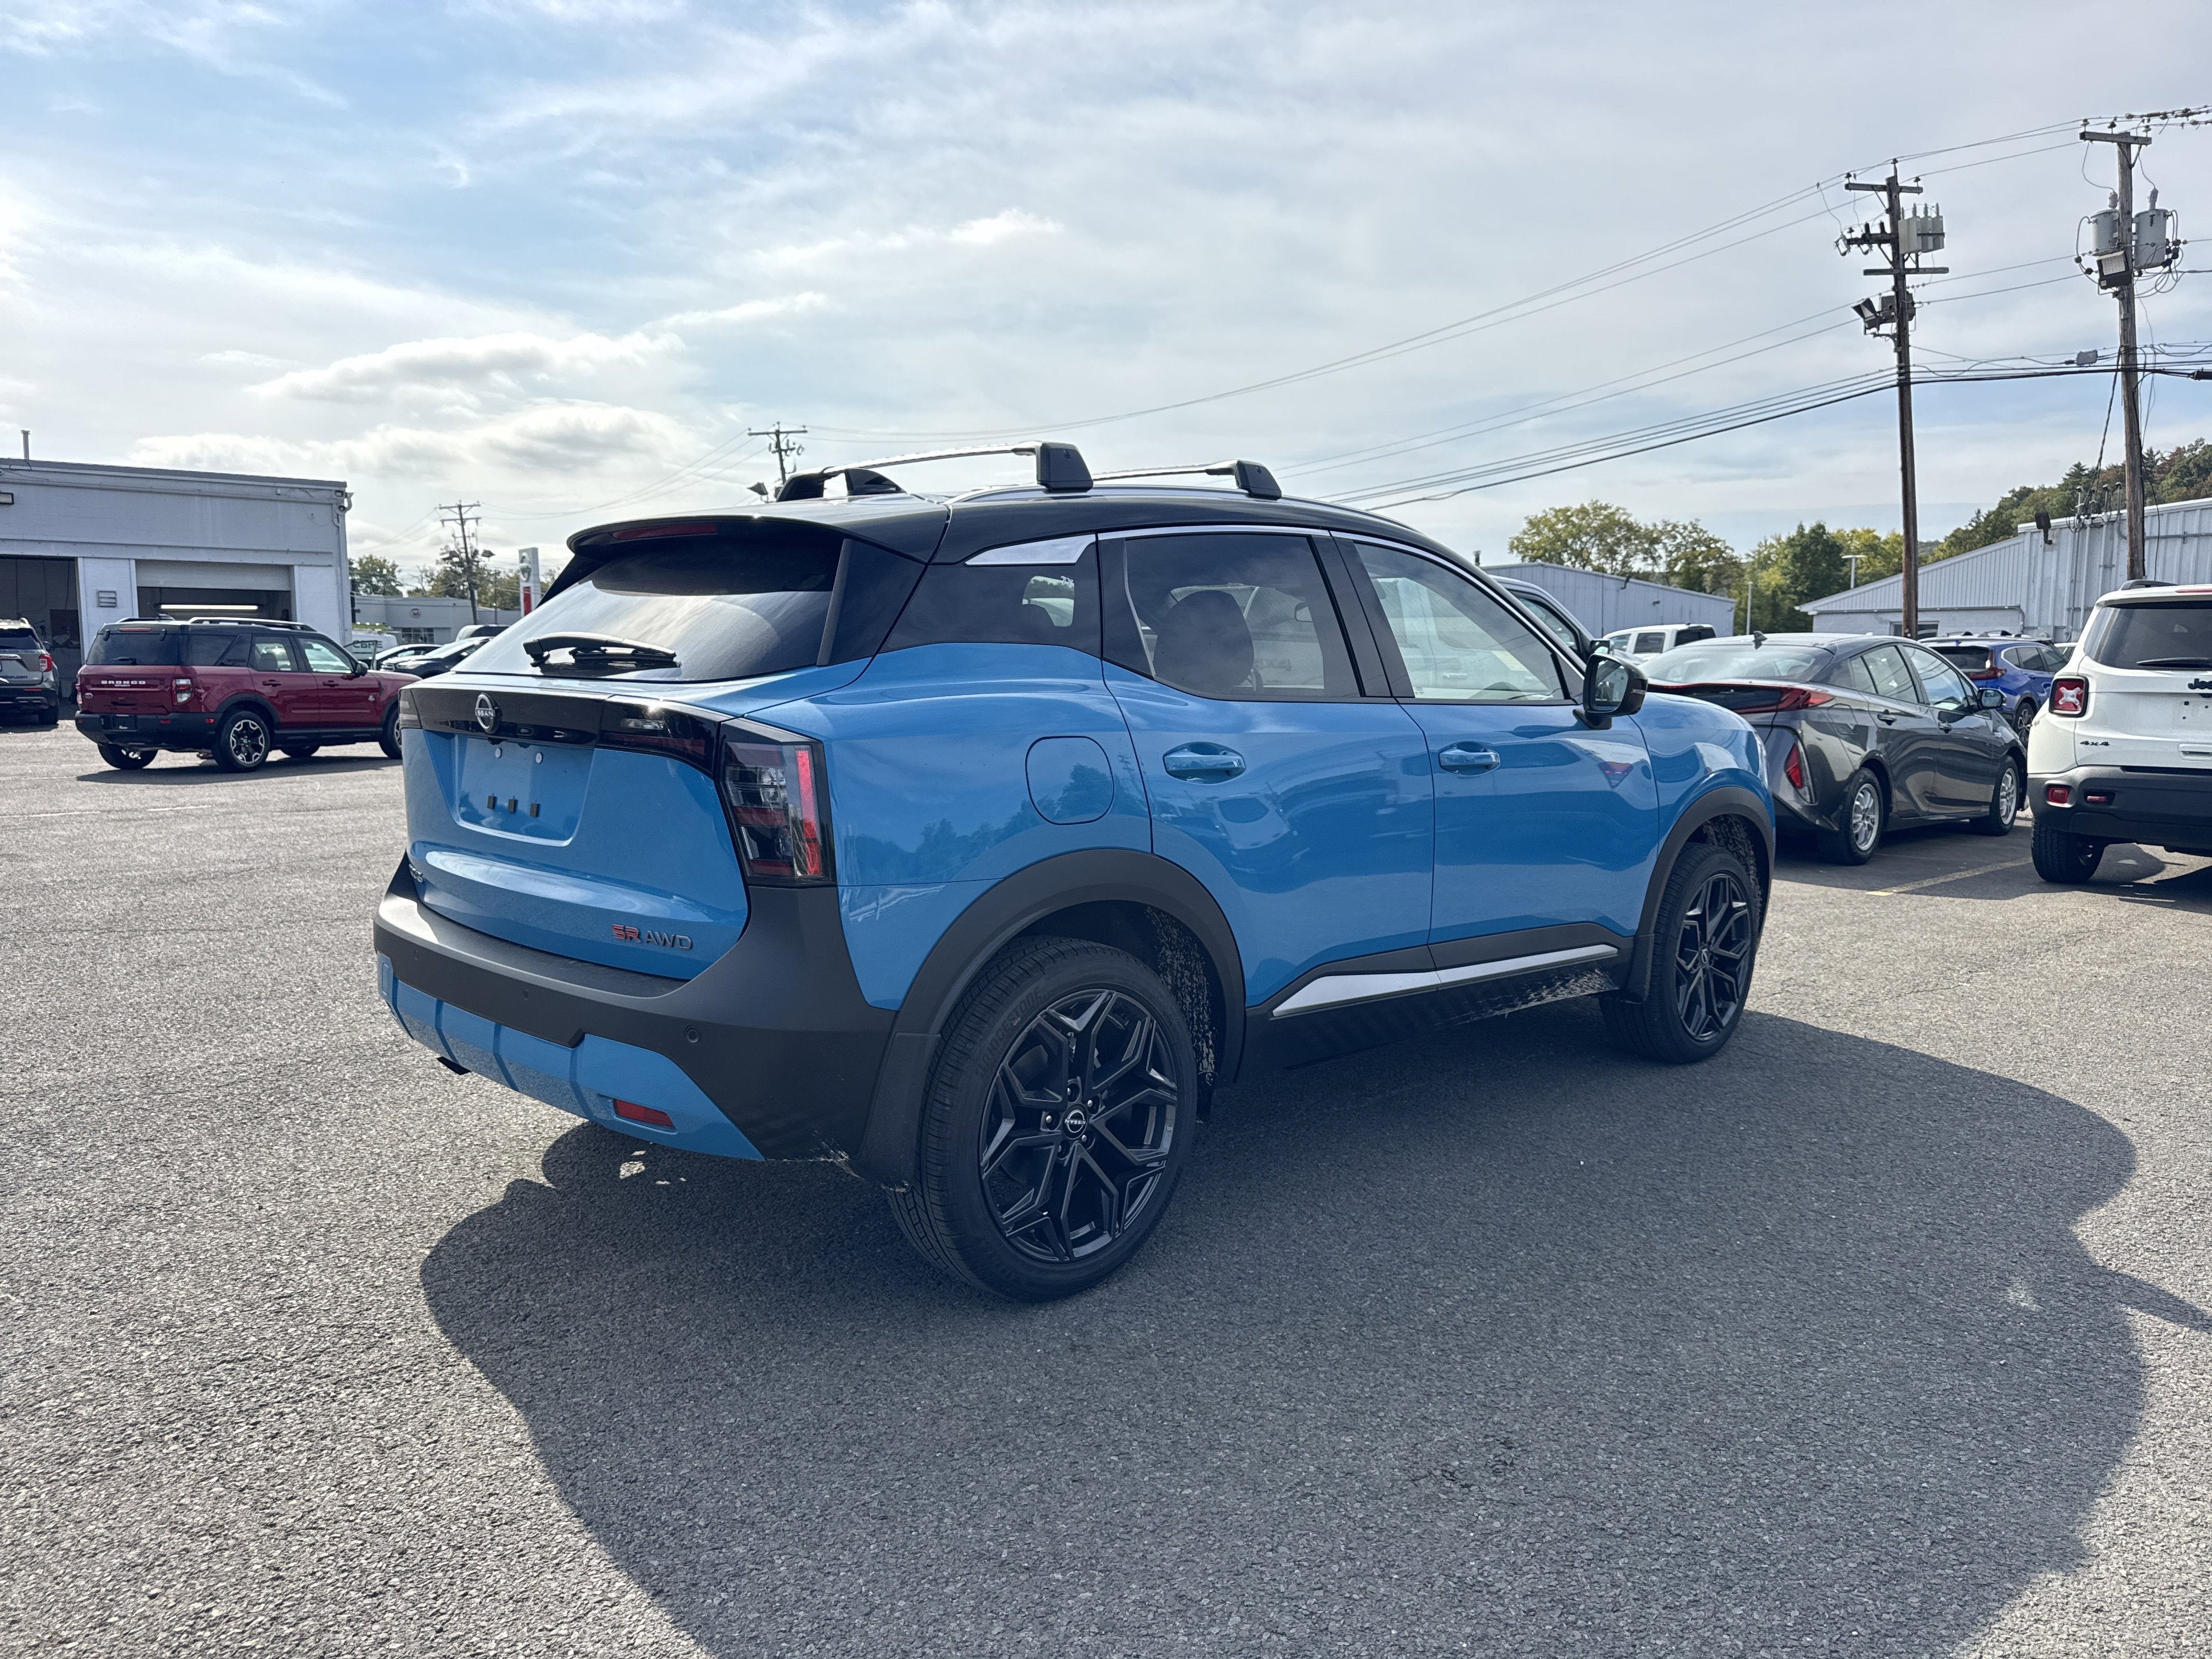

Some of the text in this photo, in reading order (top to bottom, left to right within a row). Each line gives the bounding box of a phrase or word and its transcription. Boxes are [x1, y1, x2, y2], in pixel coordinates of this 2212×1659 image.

[2187, 678, 2212, 690] Jee
[611, 923, 692, 950] SR AWD
